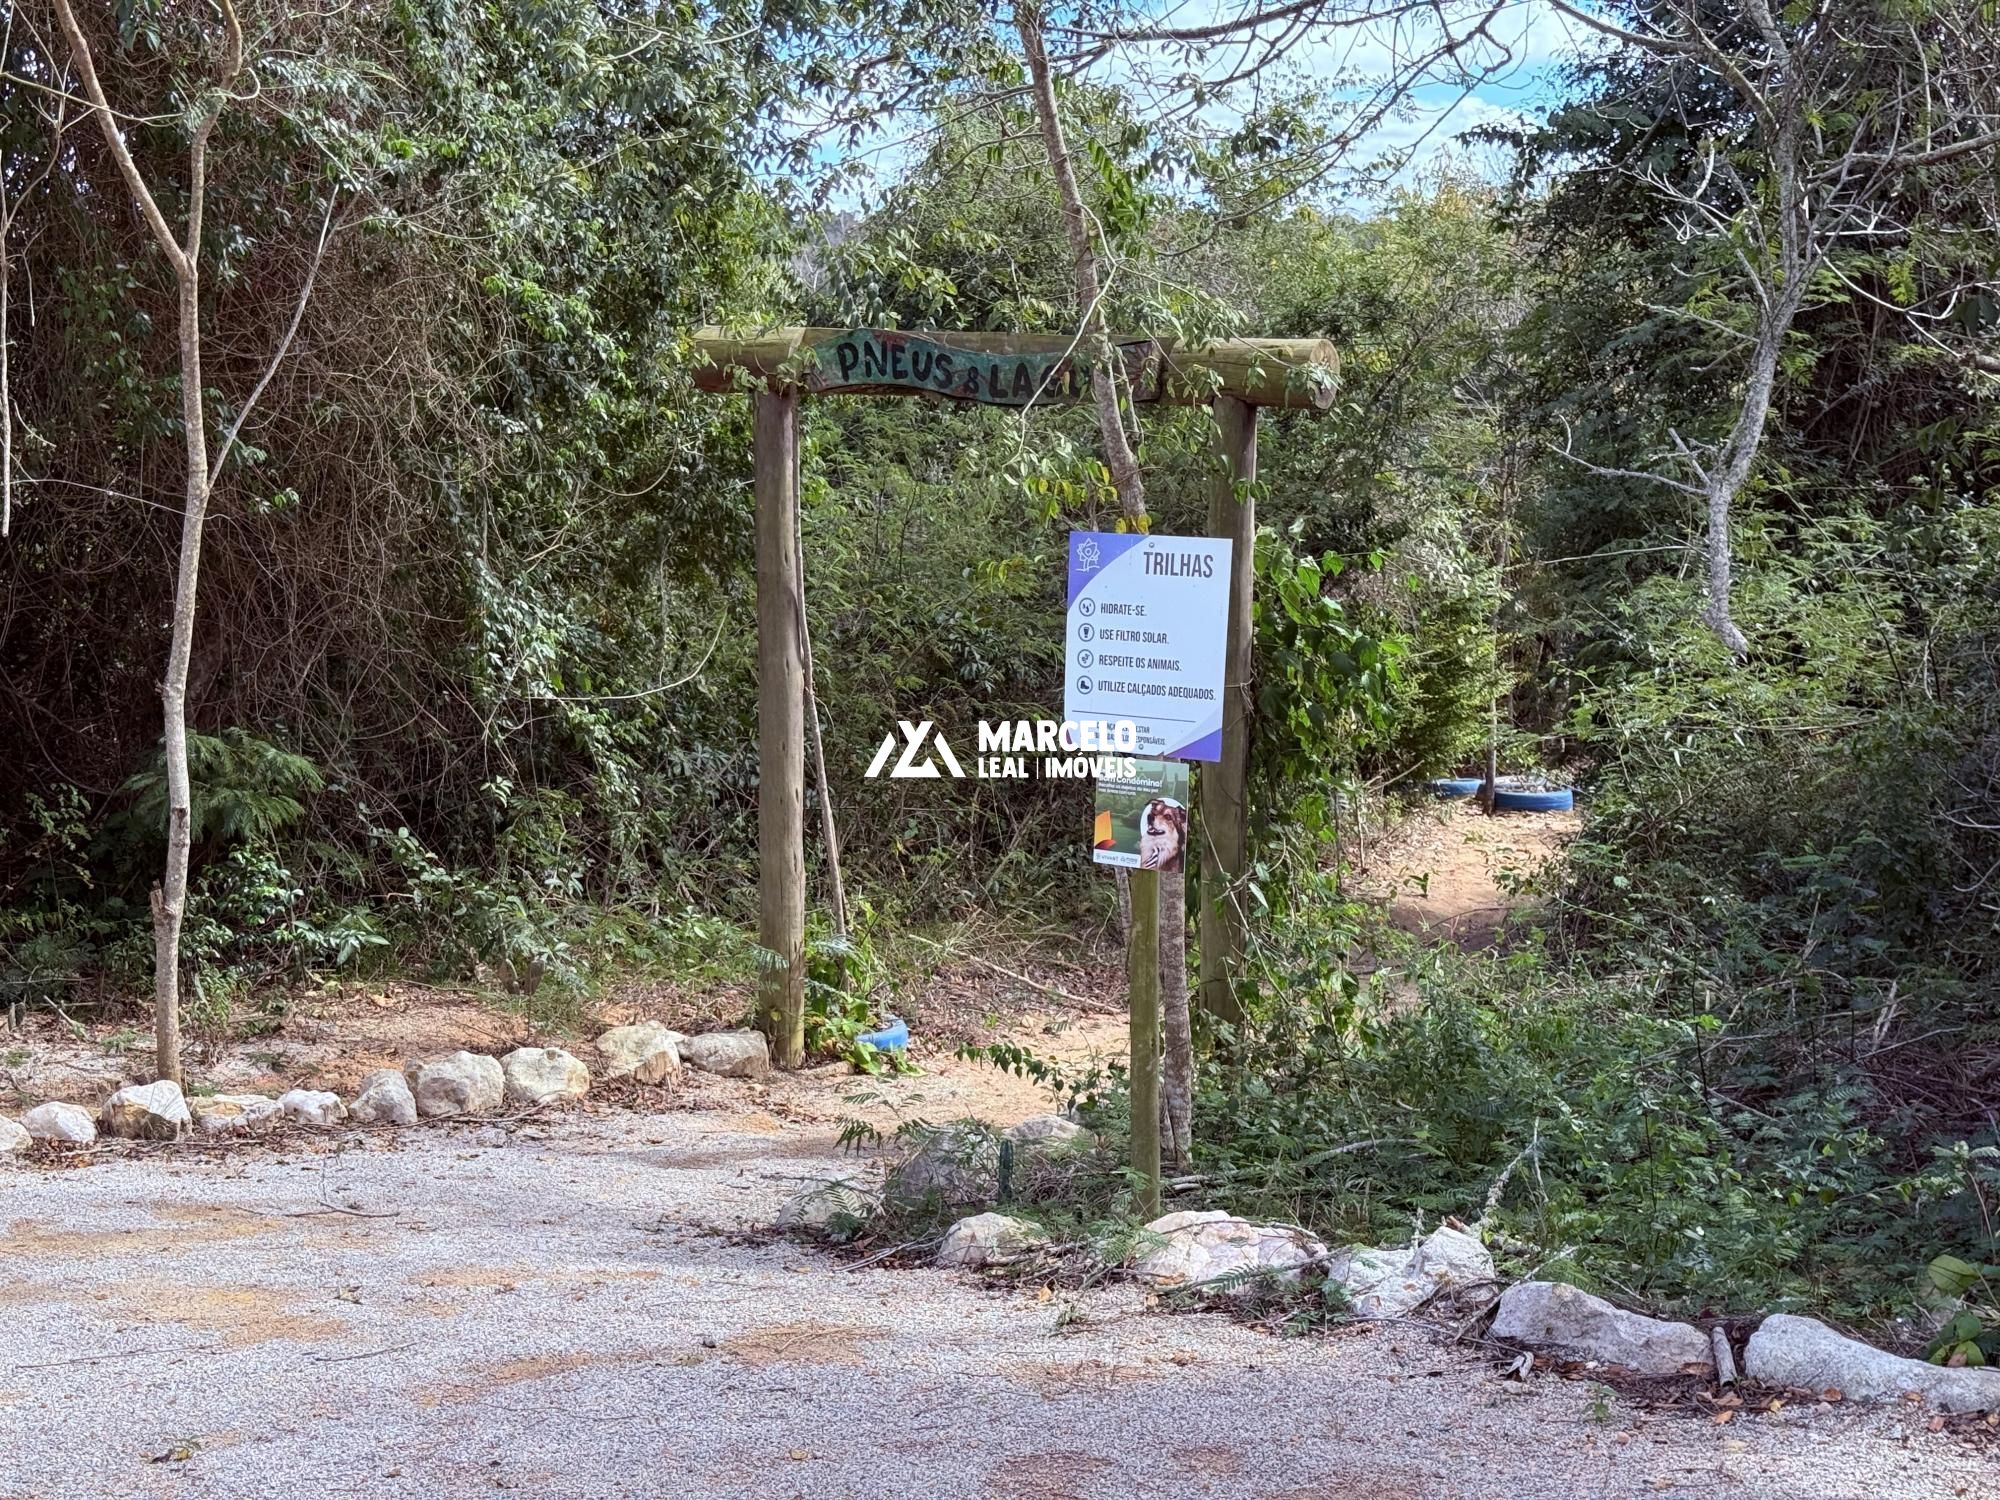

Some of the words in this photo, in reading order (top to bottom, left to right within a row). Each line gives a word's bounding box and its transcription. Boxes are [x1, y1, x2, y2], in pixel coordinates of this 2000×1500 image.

[836, 341, 953, 390] PNEUS
[1143, 551, 1214, 579] TRILHAS
[1100, 602, 1147, 617] HIDRATE-SE.
[1099, 629, 1114, 641] USE
[1115, 629, 1141, 643] FILTRO
[1142, 631, 1169, 645] SOLAR.
[1098, 654, 1134, 668] RESPEITE
[1135, 656, 1146, 668] OS
[1147, 656, 1182, 672] ANIMAIS.
[1098, 680, 1126, 694] UTILIZE
[1127, 682, 1166, 697] CALÇADOS
[1167, 684, 1216, 701] ADEQUADOS.
